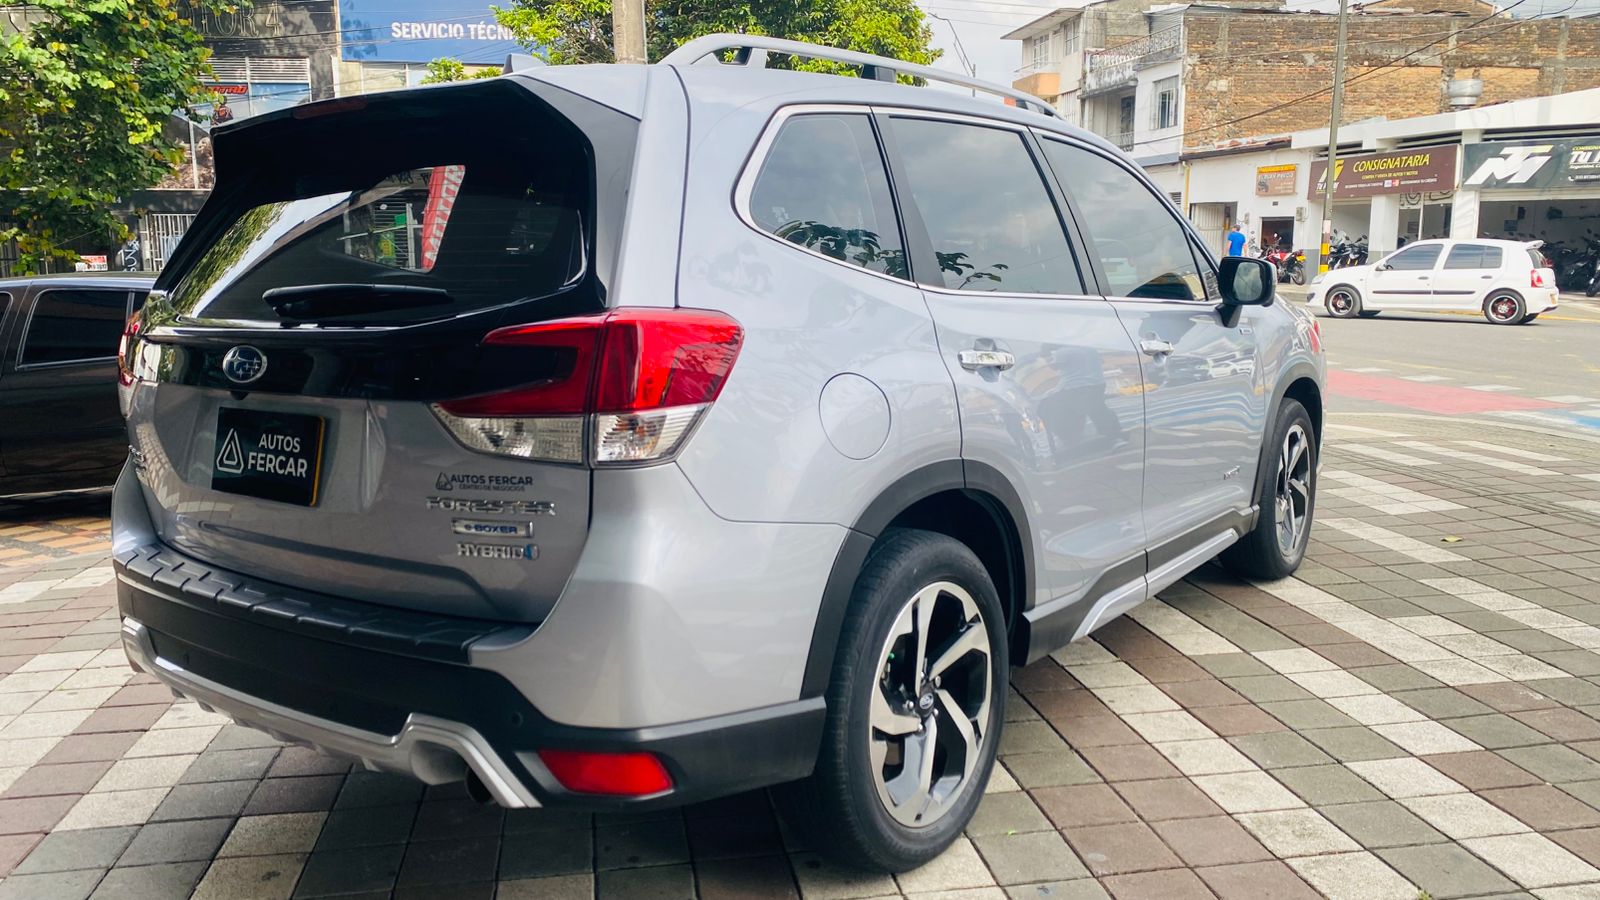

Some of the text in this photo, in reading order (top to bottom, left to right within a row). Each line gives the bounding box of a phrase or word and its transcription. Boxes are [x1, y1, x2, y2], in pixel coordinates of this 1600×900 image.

[266, 2, 283, 37] 4
[391, 22, 464, 40] SERVICIO
[1352, 153, 1430, 173] CONSIGNATARIA
[258, 433, 301, 453] AUTOS
[247, 452, 308, 478] FERCAR
[450, 474, 533, 486] AUTOS FERCAR
[425, 496, 556, 516] FORESTER
[463, 523, 518, 534] e-BOXER
[456, 543, 524, 560] HYBRID
